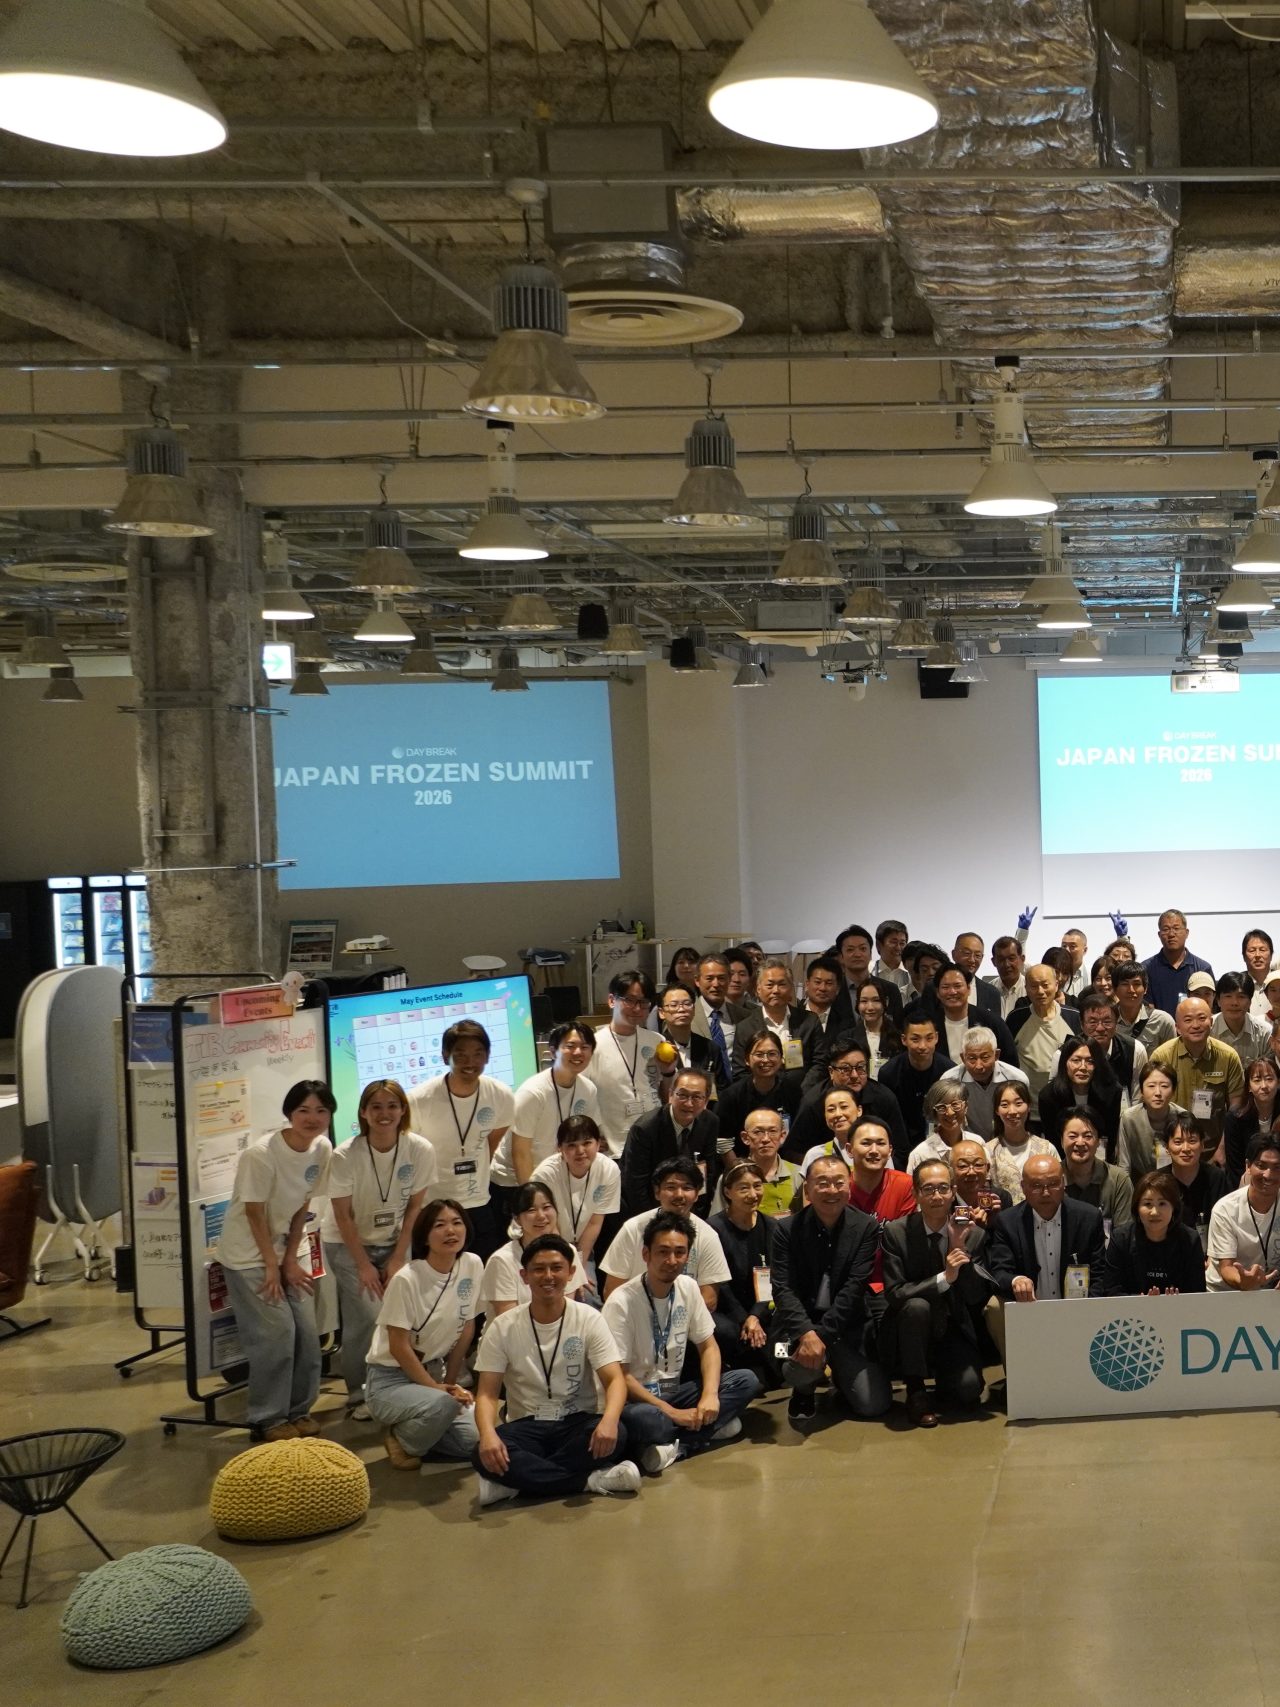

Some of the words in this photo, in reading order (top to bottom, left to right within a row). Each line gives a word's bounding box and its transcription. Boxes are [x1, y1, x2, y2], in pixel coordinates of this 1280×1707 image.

[1174, 730, 1217, 740] DAYBREAK
[406, 747, 457, 757] DAYBREAK
[1056, 747, 1136, 767] JAPAN
[1143, 744, 1236, 764] FROZEN
[370, 762, 480, 784] FROZEN
[488, 760, 594, 782] SUMMIT
[1180, 768, 1213, 783] 2026
[414, 789, 453, 806] 2026
[400, 997, 415, 1006] May
[415, 994, 433, 1005] Event
[434, 991, 463, 1001] Schedule
